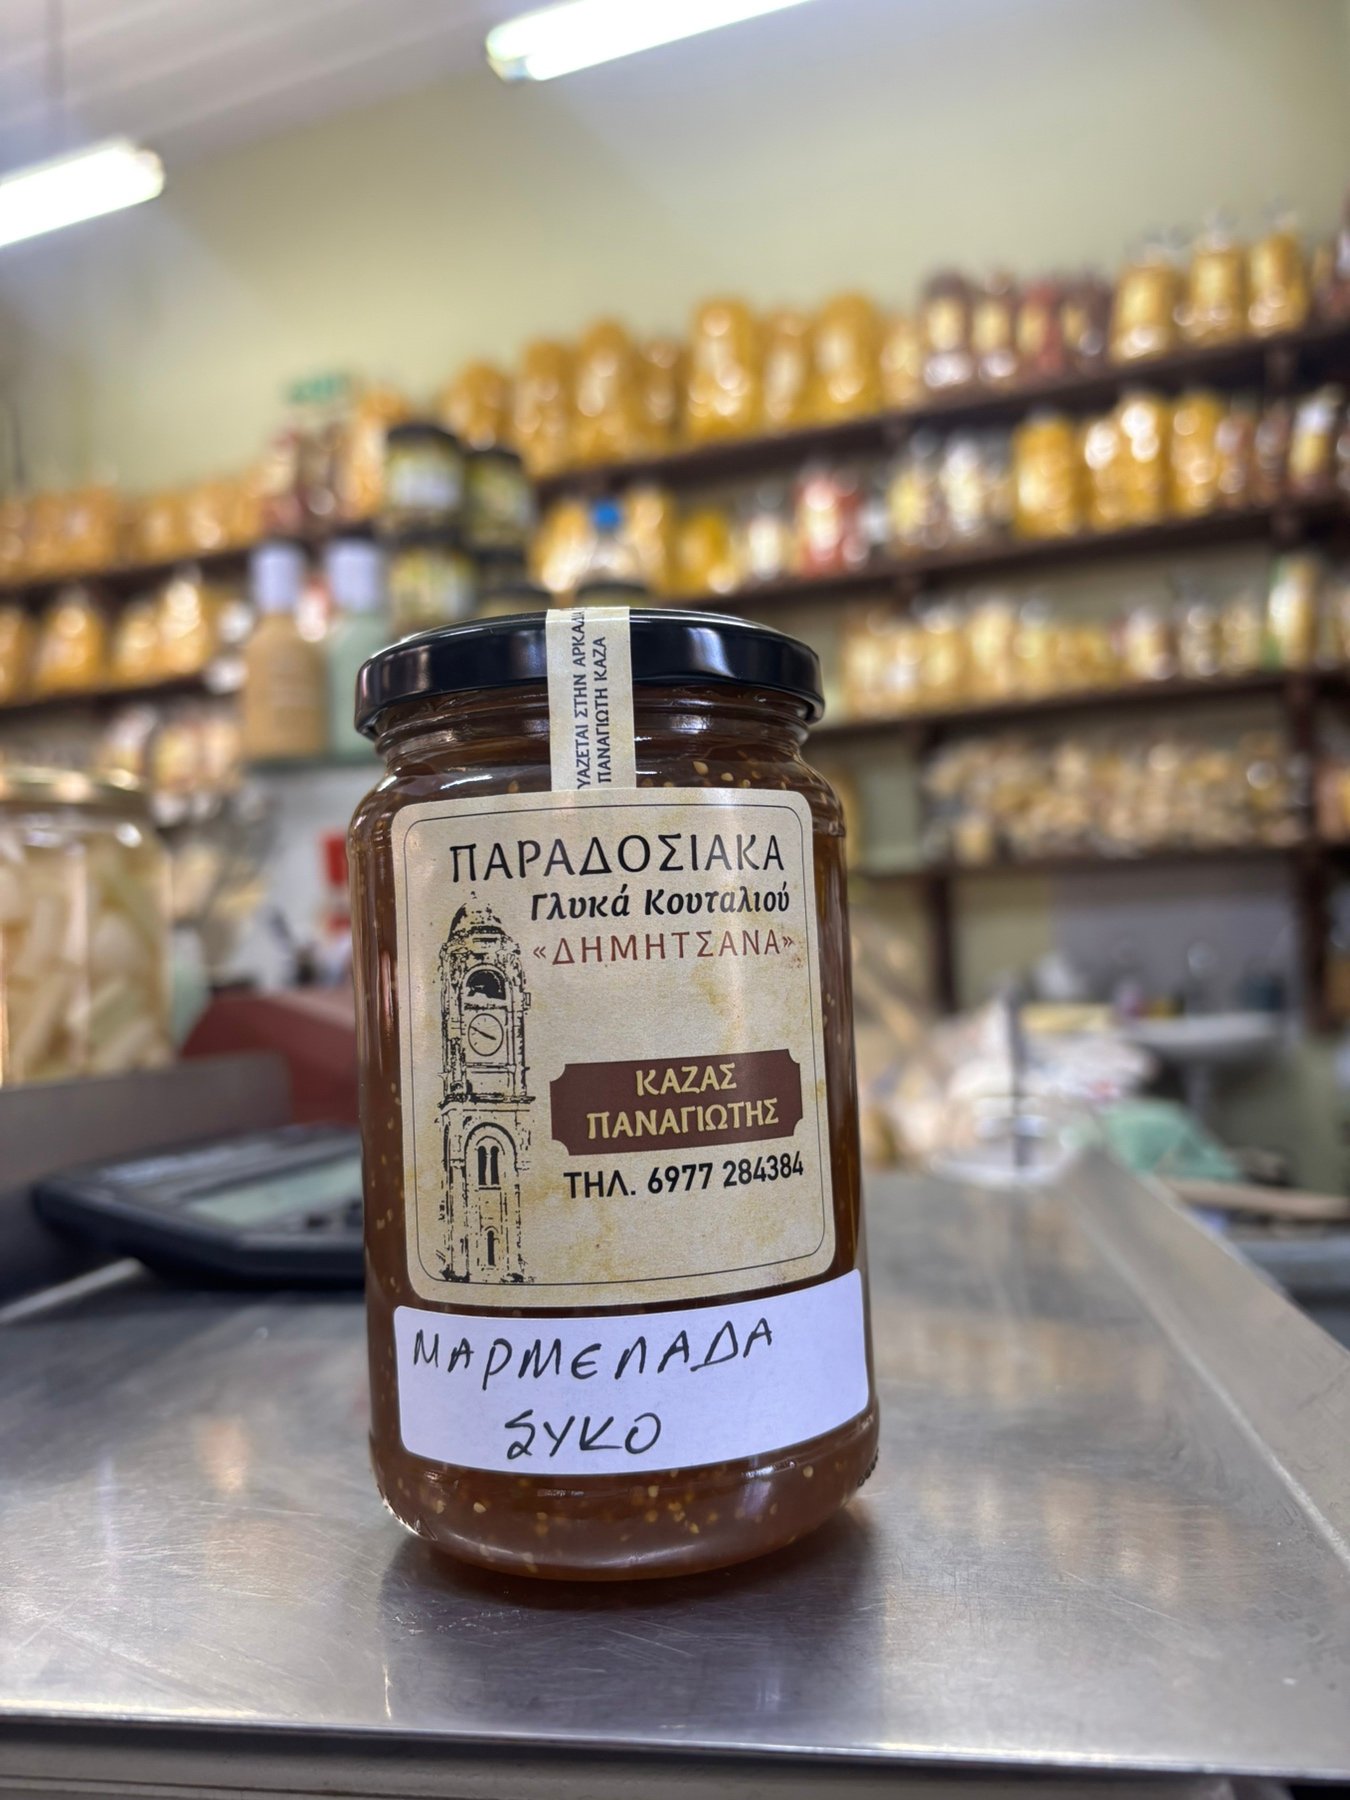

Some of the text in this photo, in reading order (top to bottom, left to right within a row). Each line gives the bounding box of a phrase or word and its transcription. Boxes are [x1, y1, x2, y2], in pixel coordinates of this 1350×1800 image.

[573, 674, 588, 718] ΣΤΗΝ
[592, 636, 612, 783] ΠΑΝΑΓΙΩΤΗ ΚΑΖΑ
[449, 833, 785, 883] ΠΑΡΑΔΟΣΙΑΚΑ
[531, 882, 790, 921] Γλυκά Κουταλιού
[532, 928, 795, 966] «ΔΗΜΗΤΣΑΝΑ»
[635, 1062, 737, 1097] ΚΑΖΑΣ
[586, 1097, 779, 1140] ΠΑΝΑΓΙΩΤΗΣ
[563, 1151, 804, 1199] ΤΗΛ. 6977 284384
[412, 1317, 774, 1391] ΜΑΡΜΕΛΑΔΑ
